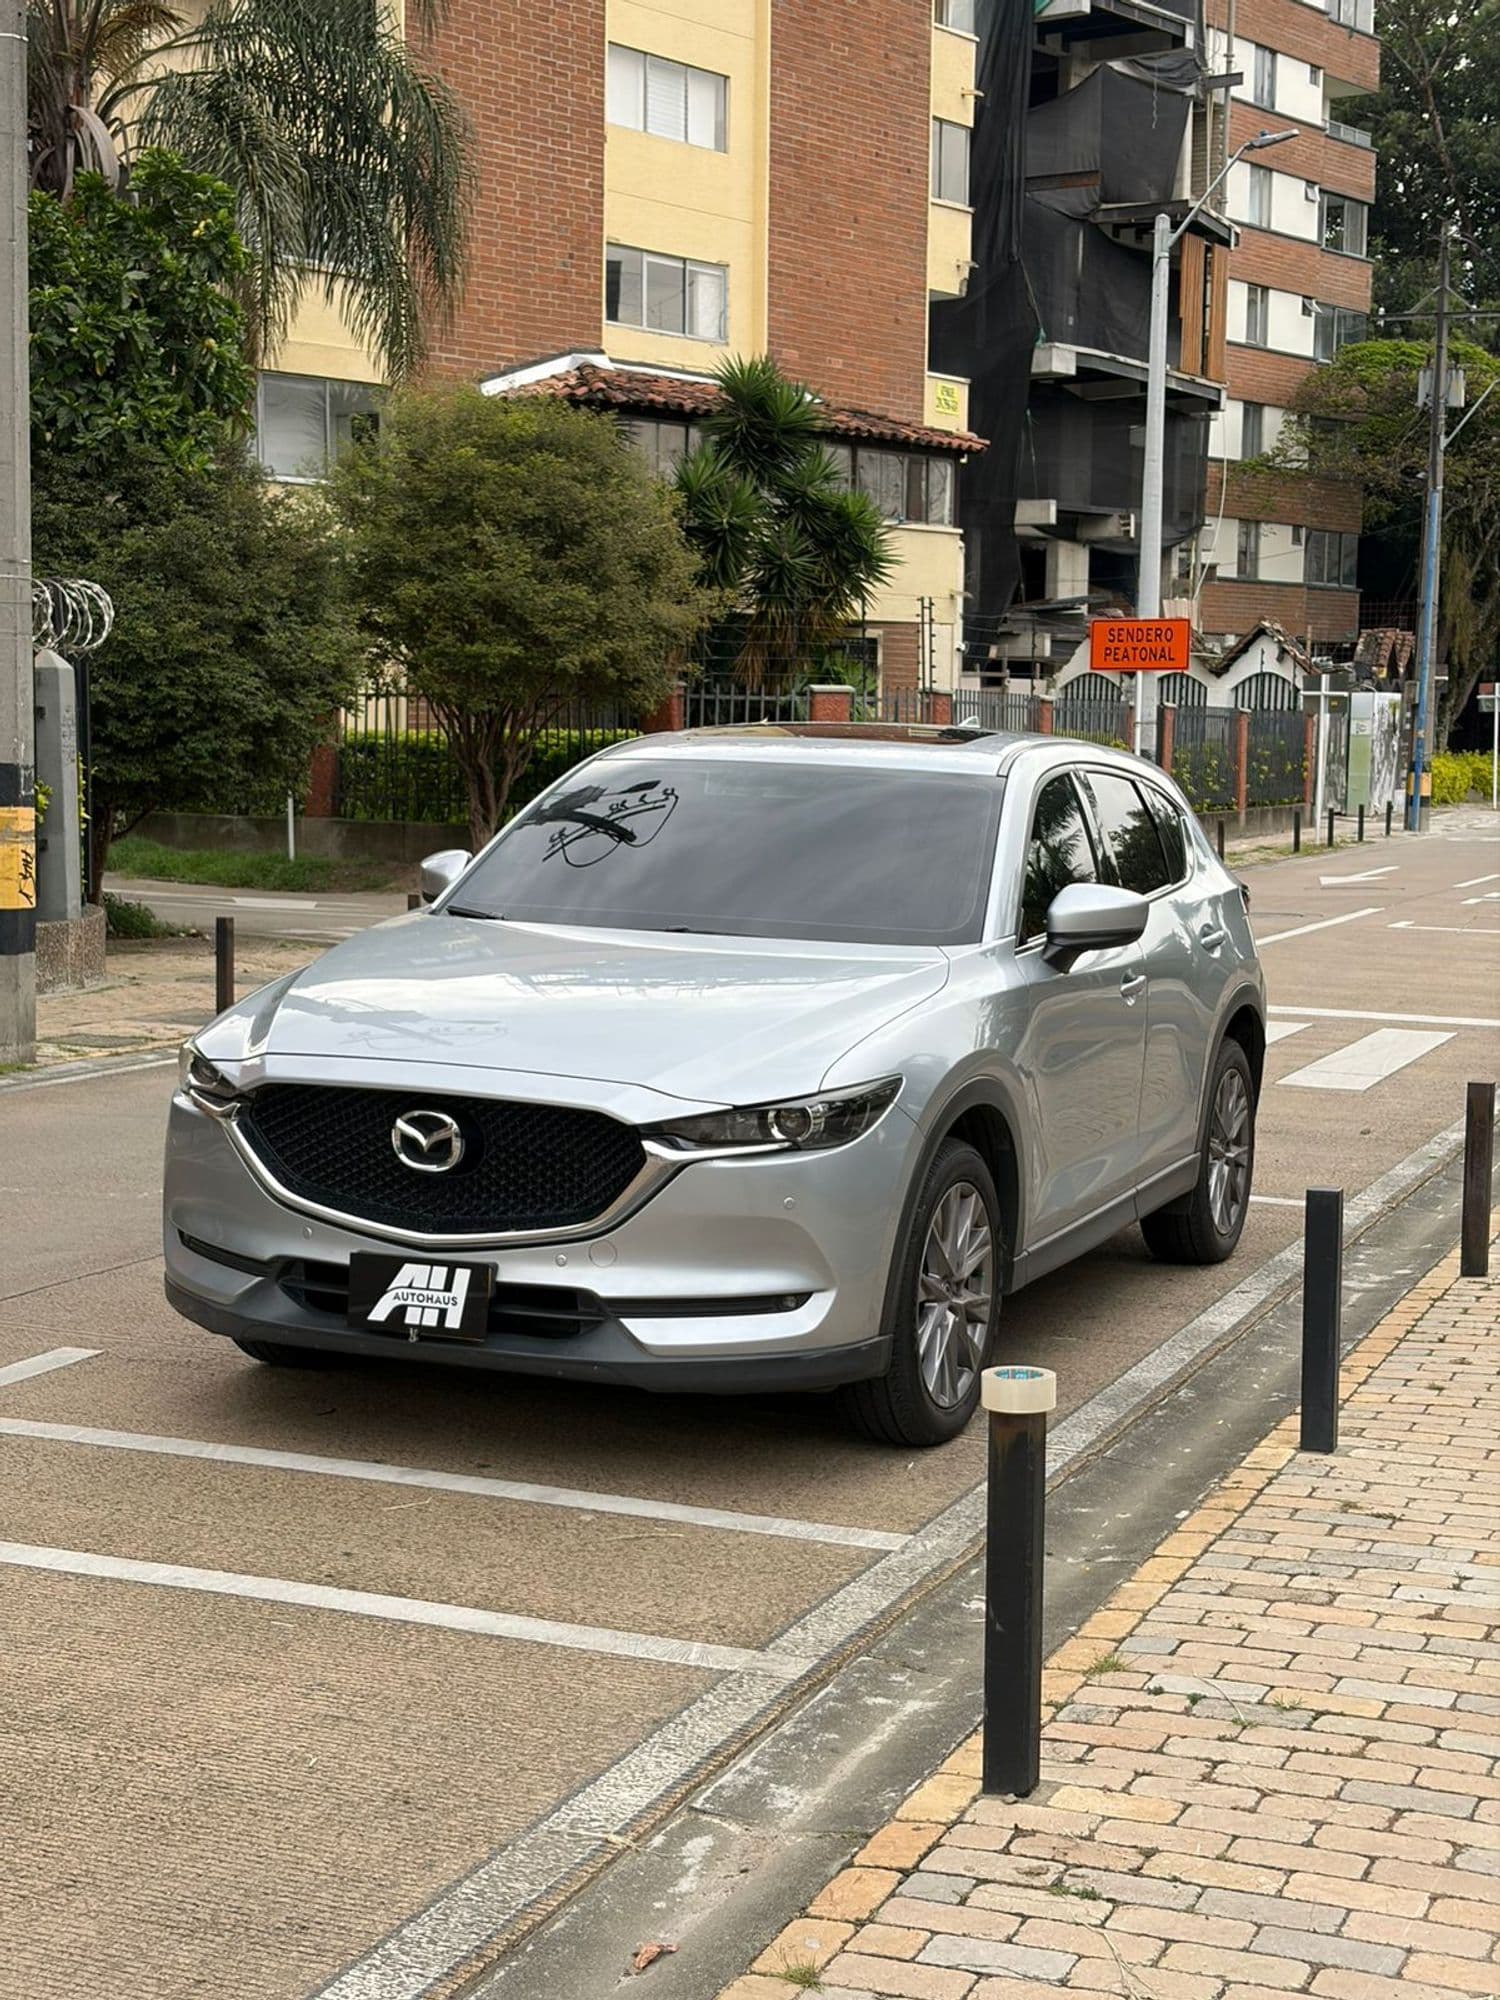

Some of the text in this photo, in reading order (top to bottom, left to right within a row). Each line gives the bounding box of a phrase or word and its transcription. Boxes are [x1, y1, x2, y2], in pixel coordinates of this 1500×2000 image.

[1107, 627, 1174, 643] SENDERO
[1103, 646, 1175, 662] PEATONAL
[393, 1291, 458, 1306] AUTOHAUS
